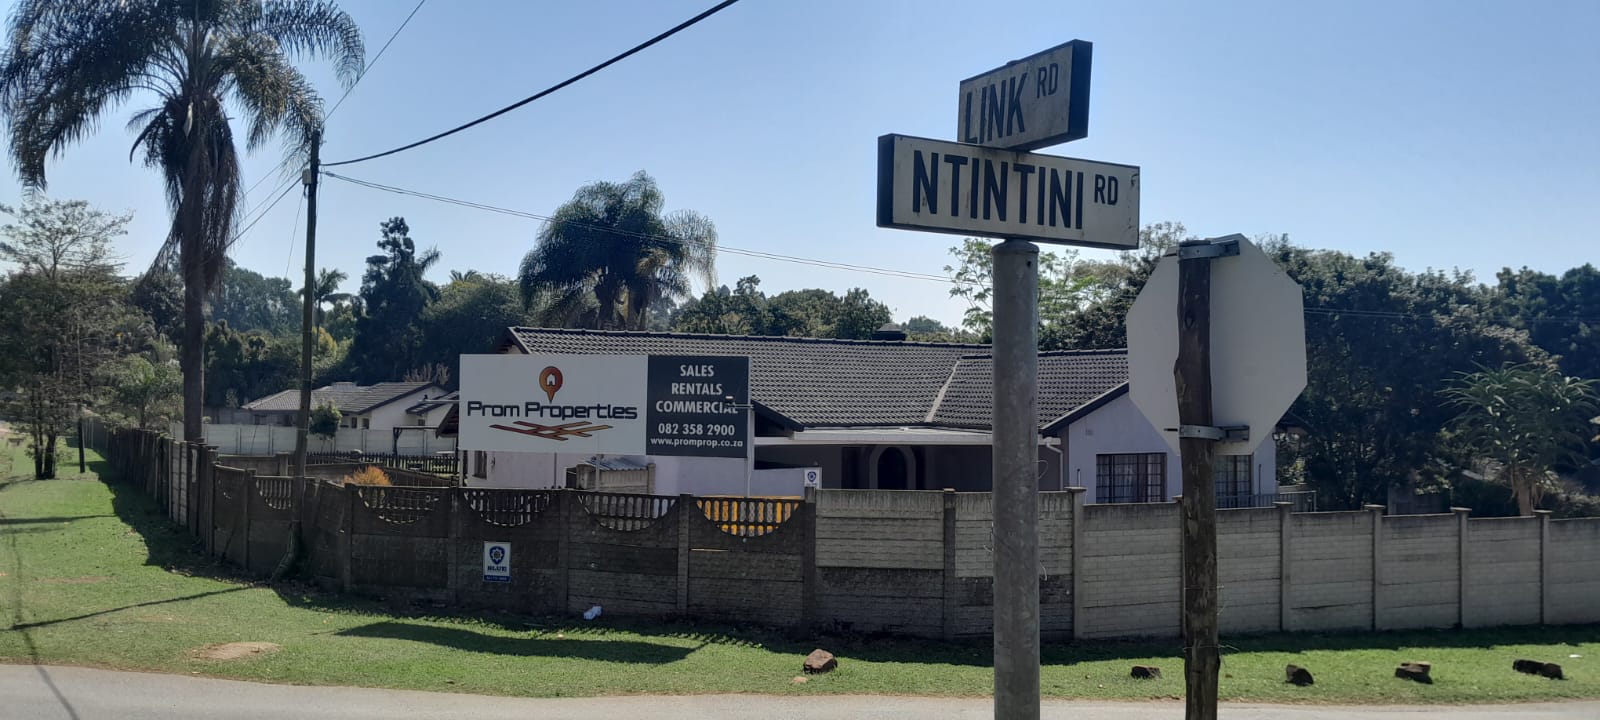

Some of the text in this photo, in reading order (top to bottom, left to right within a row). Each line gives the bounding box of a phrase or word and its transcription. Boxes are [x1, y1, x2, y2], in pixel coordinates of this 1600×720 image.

[964, 63, 1059, 144] LINK RD
[912, 149, 1119, 230] NTINTINI RD
[680, 365, 715, 377] SALES
[671, 382, 723, 395] RENTALS
[467, 401, 520, 417] Prom
[658, 423, 735, 436] 082 358 2900
[650, 437, 743, 448] www.promprop.co.za
